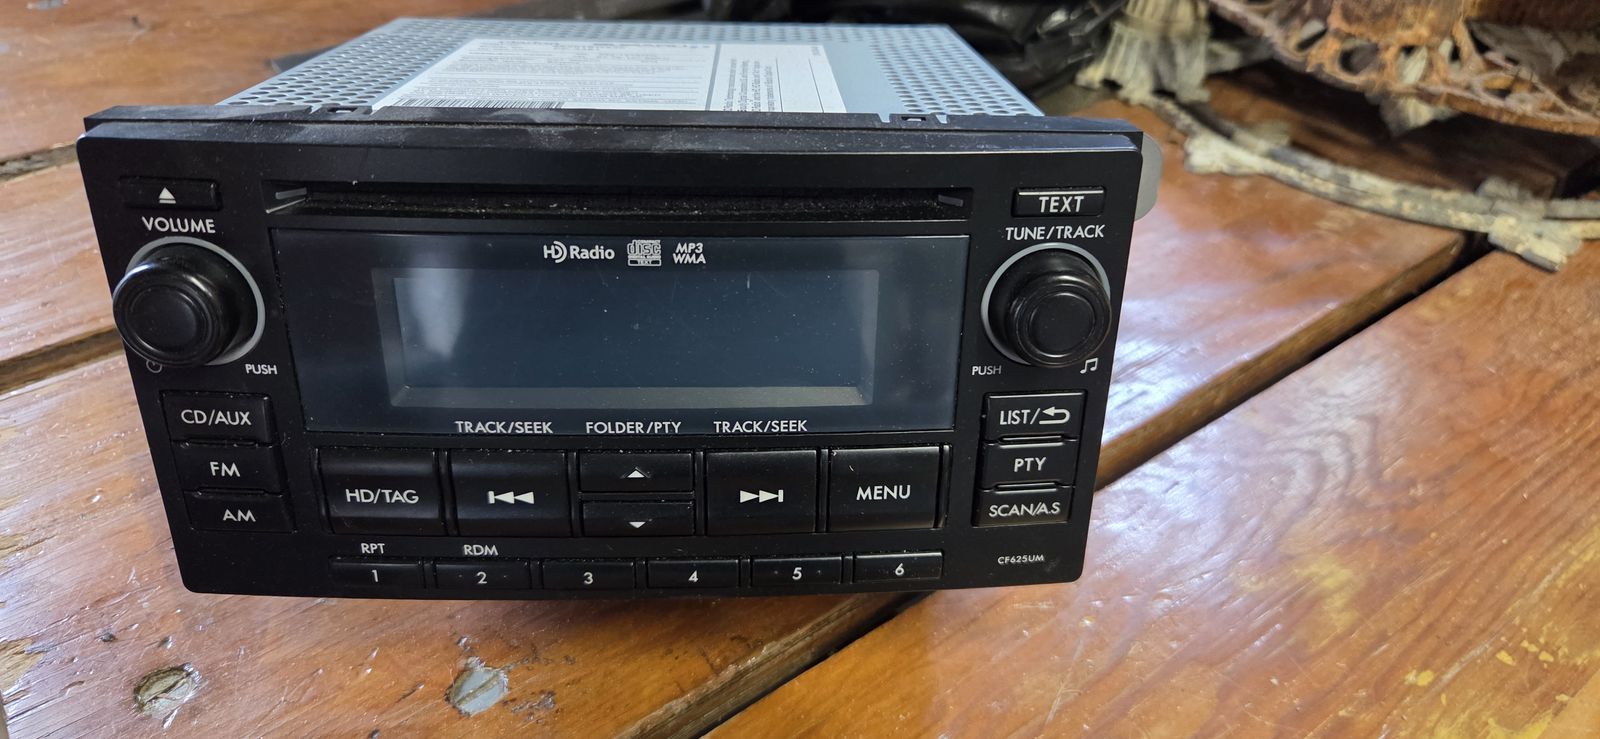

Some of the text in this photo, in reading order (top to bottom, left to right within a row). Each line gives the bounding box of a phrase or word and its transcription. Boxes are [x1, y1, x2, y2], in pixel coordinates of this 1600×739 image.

[1039, 196, 1084, 213] TEXT
[142, 216, 216, 234] VOLUME
[1005, 224, 1106, 241] TUNE/TRACK
[569, 244, 616, 260] Radio
[675, 242, 704, 254] MP3
[672, 253, 707, 264] WMA
[245, 363, 278, 375] PUSH
[971, 365, 1002, 376] PUSH
[180, 409, 252, 426] CD/AUX
[455, 420, 554, 434] TRACK/SEEK
[585, 421, 682, 435] FOLDER/PTY
[713, 420, 808, 434] TRACK/SEEK
[209, 461, 241, 477] FM
[1013, 456, 1047, 473] PTY
[345, 488, 419, 504] HD/TAG
[856, 484, 911, 501] MENU
[222, 508, 257, 522] AM
[360, 543, 385, 554] RPT
[463, 544, 499, 556] RDM
[997, 554, 1045, 565] CF625UM
[371, 569, 379, 582] 1
[688, 570, 699, 583] 4
[791, 566, 803, 581] 5
[894, 563, 905, 577] 6
[476, 571, 488, 585] 2
[583, 572, 594, 585] 3
